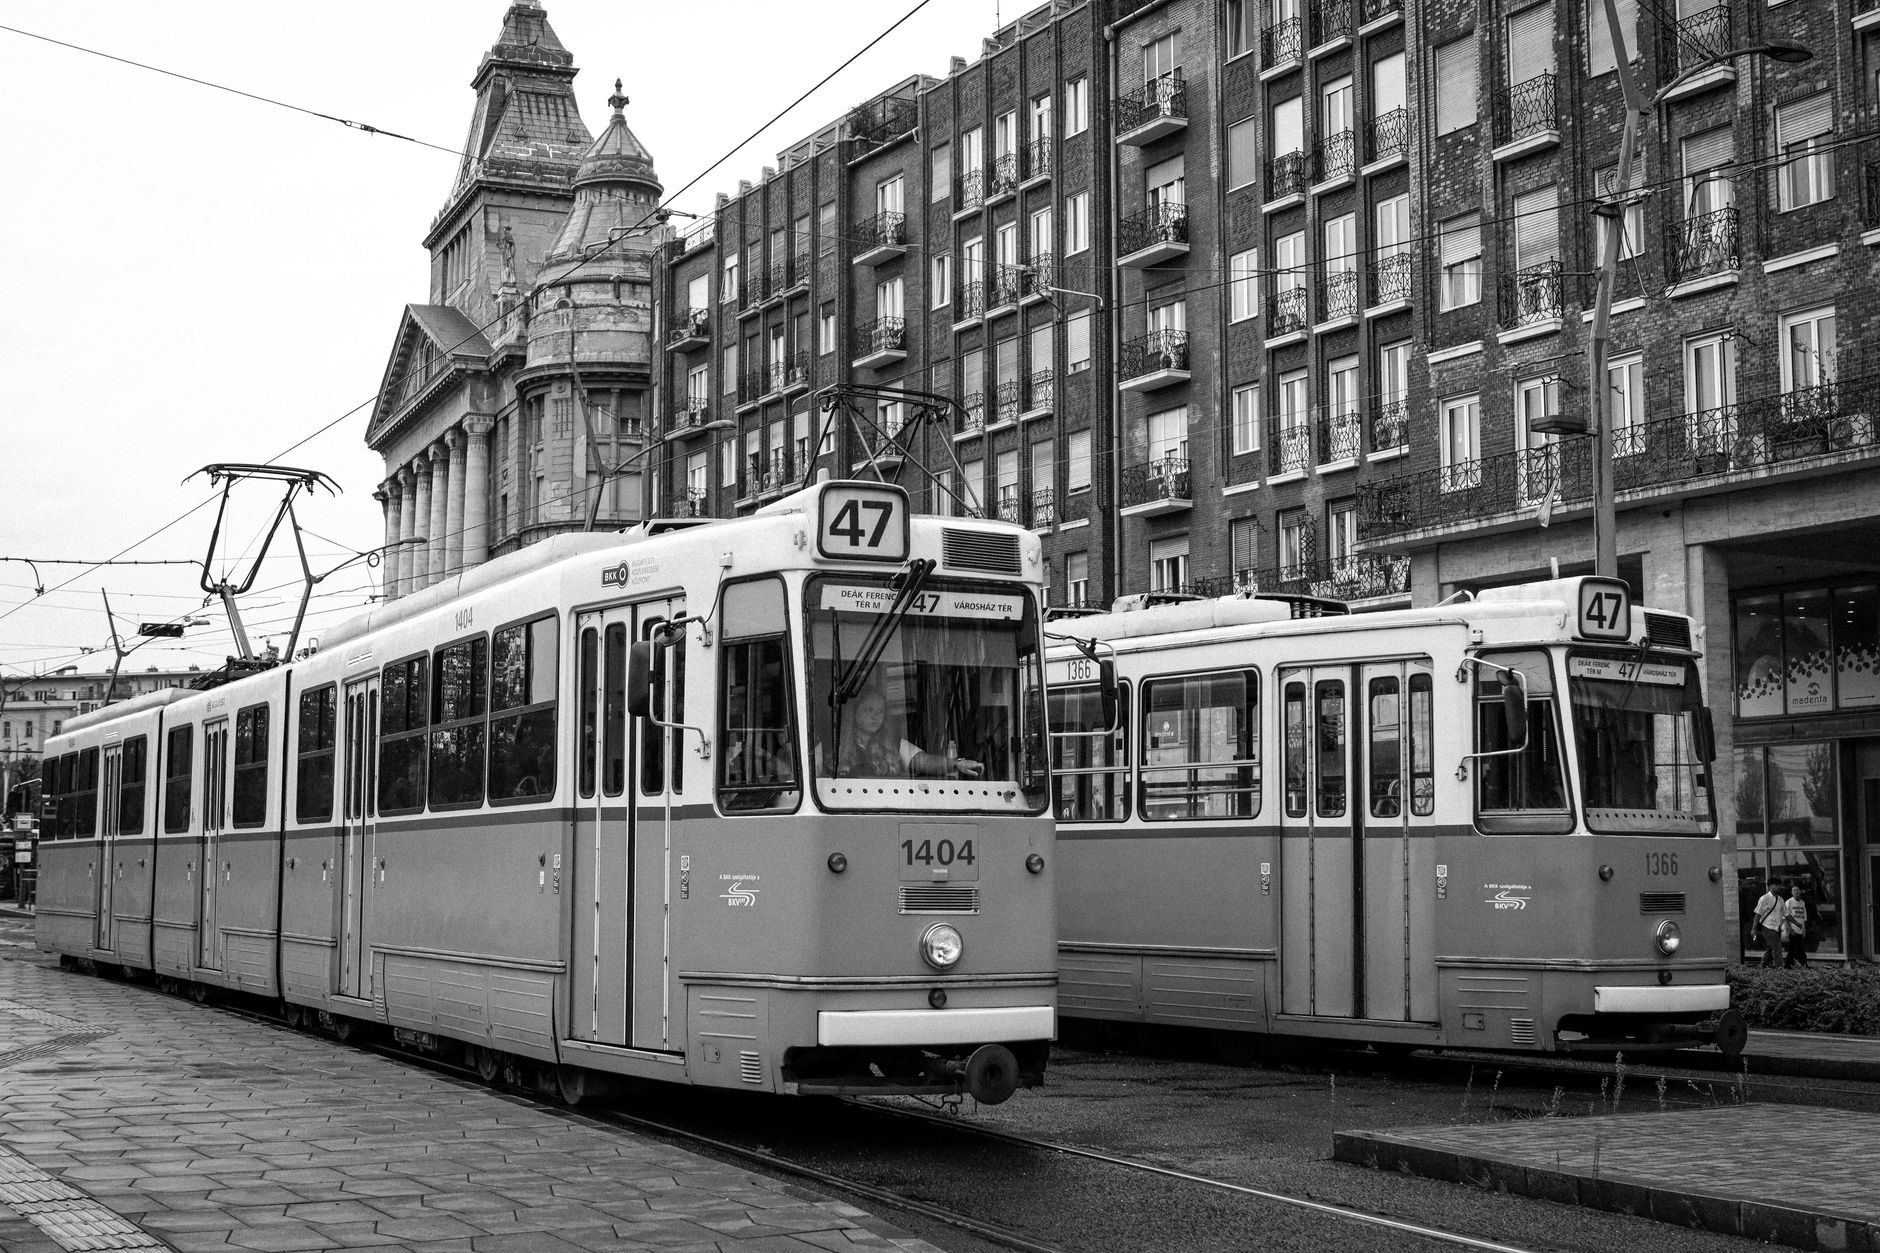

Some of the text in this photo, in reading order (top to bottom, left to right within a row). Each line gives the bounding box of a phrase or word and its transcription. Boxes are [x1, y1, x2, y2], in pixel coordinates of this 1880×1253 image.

[829, 499, 893, 547] 47
[604, 571, 617, 582] BKK
[841, 589, 897, 601] DEÁK FERENC
[855, 600, 881, 609] TÉR M
[912, 593, 941, 613] 47
[954, 601, 1013, 612] VÁROSHÁZ TÉR
[1586, 592, 1622, 630] 47
[455, 606, 473, 631] 1404
[1068, 660, 1091, 680] 1366
[1577, 659, 1591, 667] DEÁK
[1618, 663, 1635, 678] 47
[900, 839, 975, 866] 1404
[1645, 852, 1678, 876] 1366
